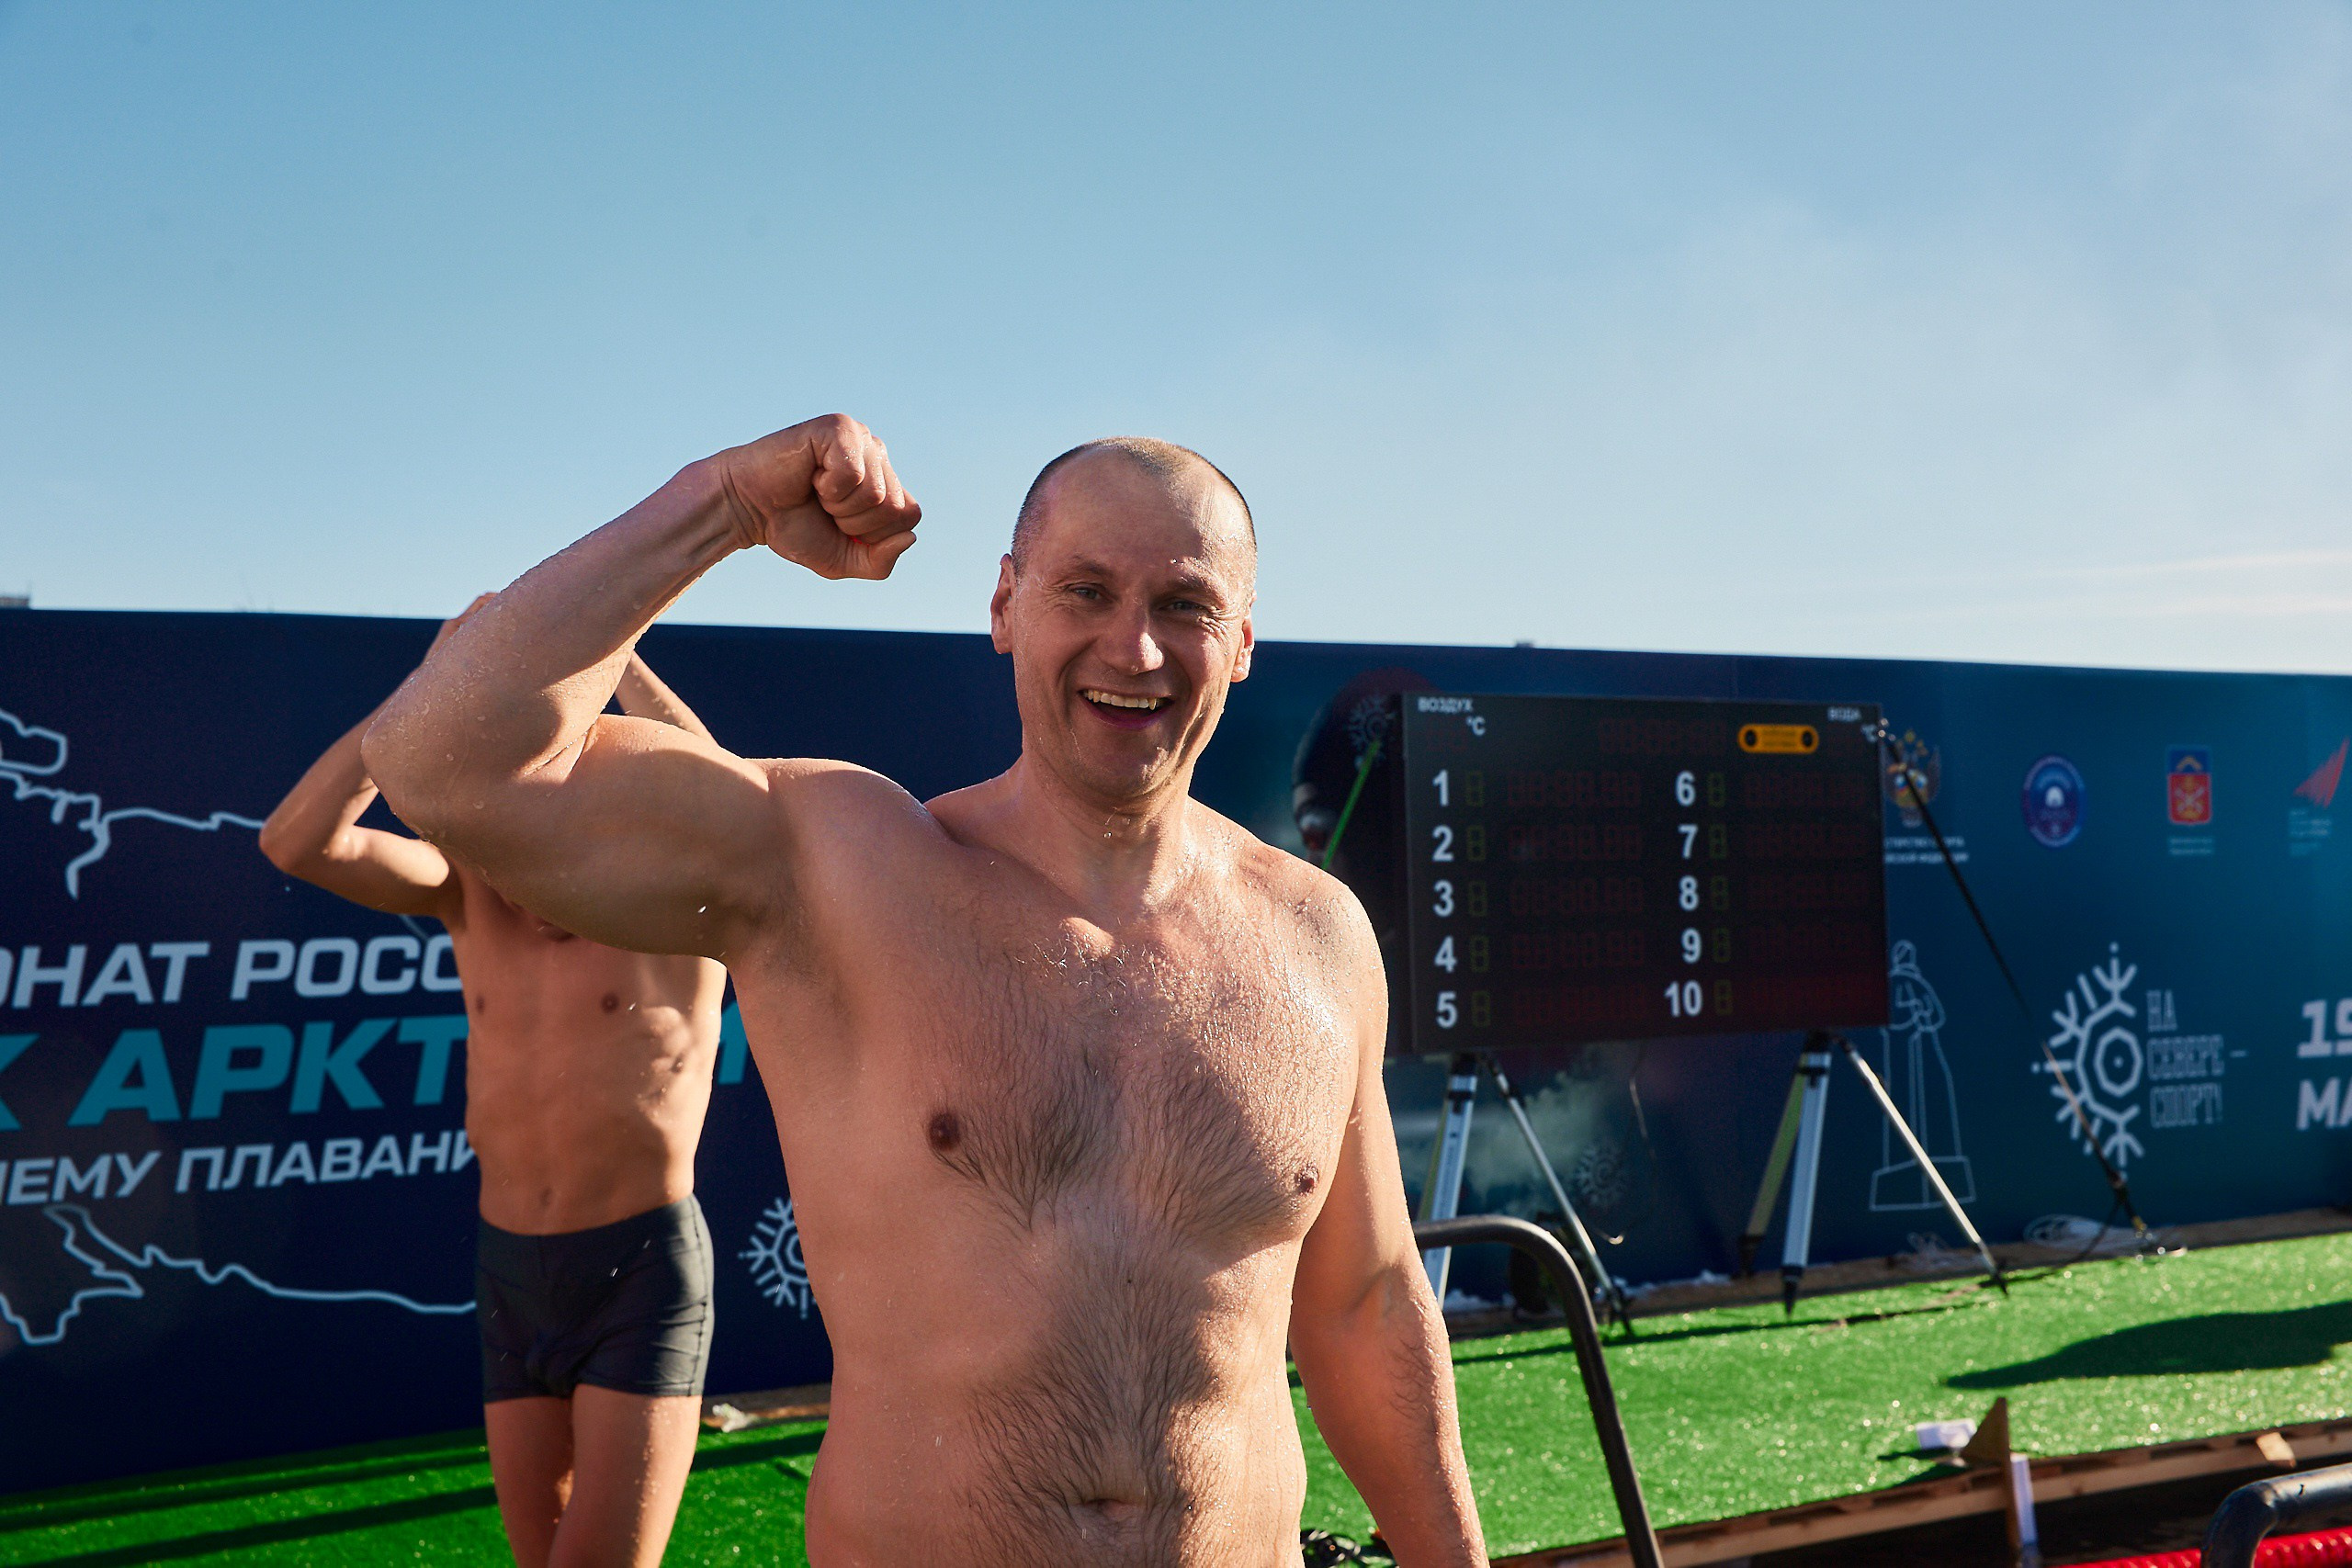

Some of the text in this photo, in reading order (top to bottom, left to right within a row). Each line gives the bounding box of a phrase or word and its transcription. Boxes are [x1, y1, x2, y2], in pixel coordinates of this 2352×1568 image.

[1417, 696, 1475, 714] ВОЗДУХ
[1432, 770, 1450, 807] 1
[1675, 770, 1696, 807] 6
[1431, 825, 1454, 862] 2
[1678, 824, 1699, 860] 7
[1433, 880, 1454, 918] 3
[1679, 875, 1700, 912] 8
[1434, 935, 1457, 974] 4
[1681, 928, 1702, 964] 9
[0, 942, 210, 1009] НАТ
[1435, 991, 1458, 1029] 5
[1665, 980, 1703, 1018] 10
[0, 1151, 162, 1205] ЕМУ
